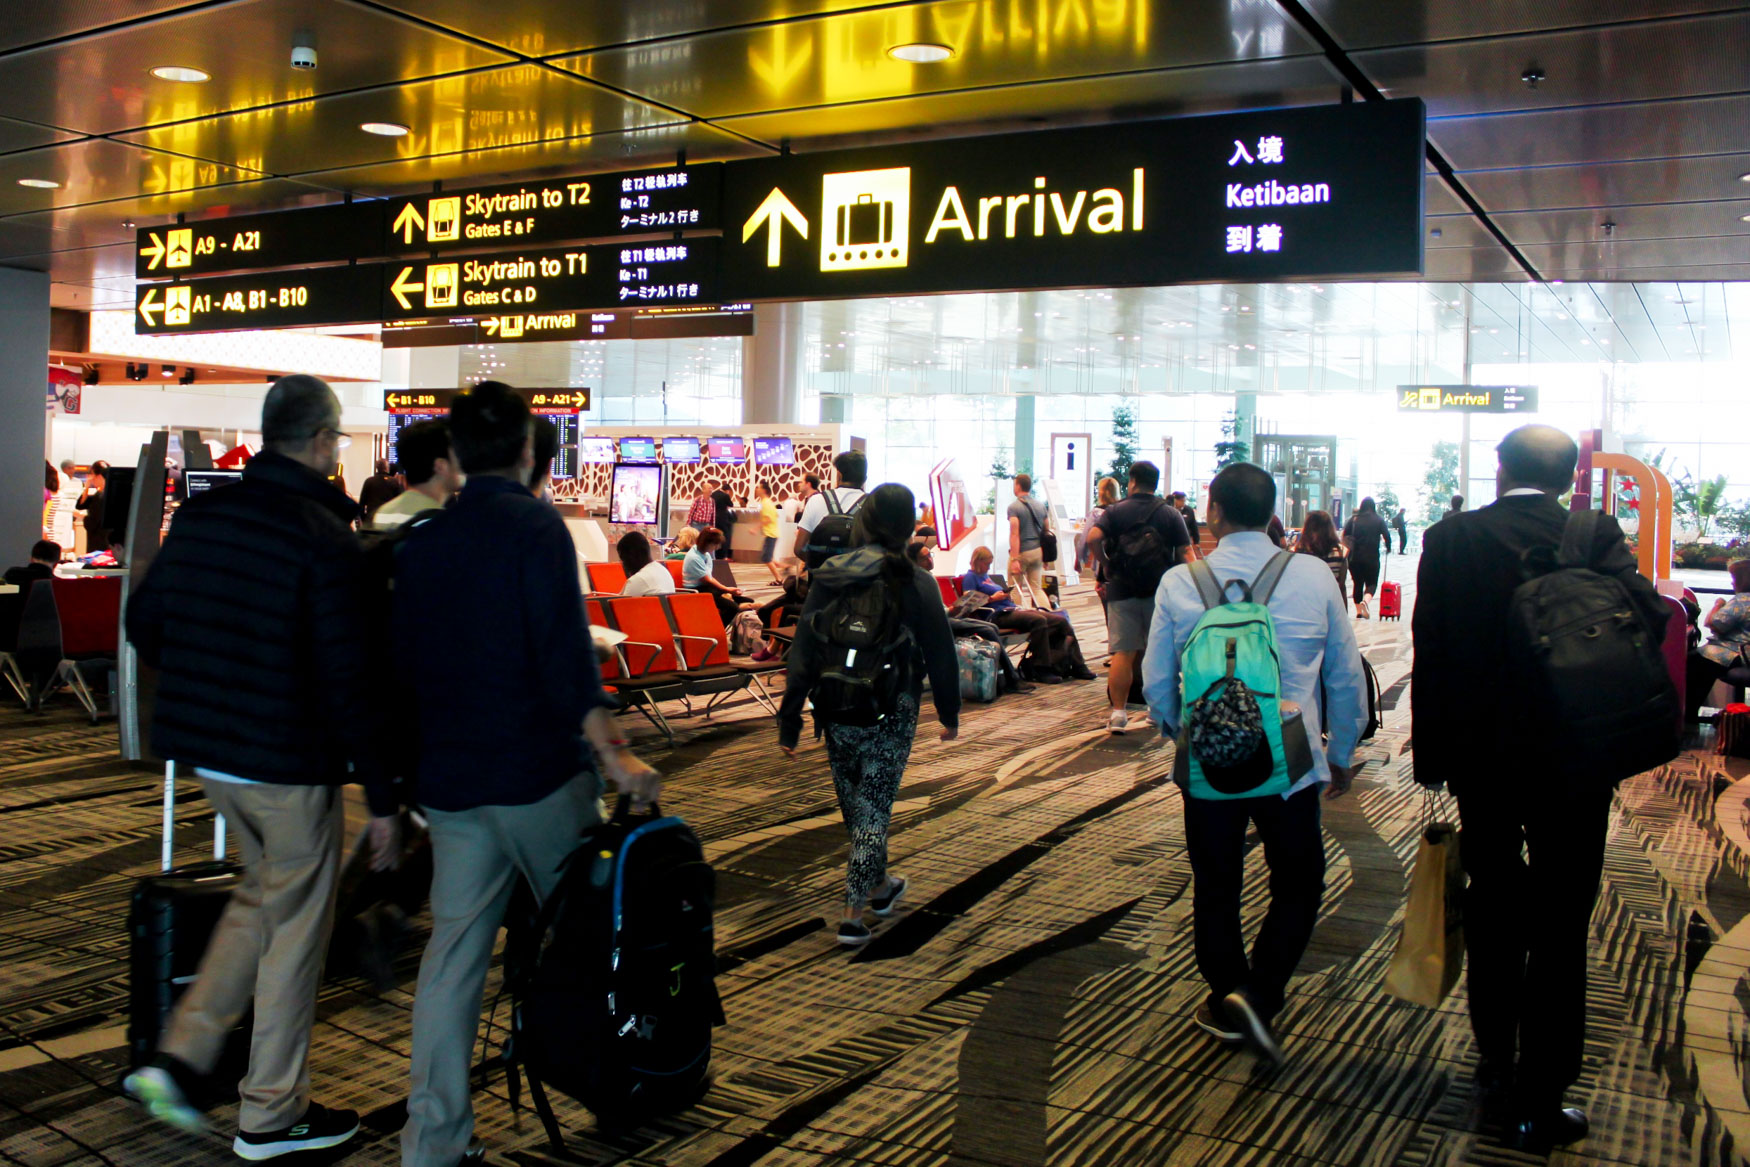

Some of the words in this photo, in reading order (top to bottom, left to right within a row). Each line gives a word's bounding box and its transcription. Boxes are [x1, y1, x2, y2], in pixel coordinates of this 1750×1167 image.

[1228, 136, 1283, 165] 入境
[466, 193, 537, 218] Skytrain
[542, 189, 563, 208] to
[567, 183, 590, 205] T2
[621, 198, 632, 209] Ke
[638, 196, 648, 207] T2
[1227, 180, 1329, 207] Ketibaan
[925, 168, 1143, 243] Arrival
[466, 224, 501, 238] Gates
[504, 220, 512, 235] E
[515, 222, 523, 234] &
[527, 218, 534, 233] F
[1226, 224, 1282, 252] 到着
[195, 236, 215, 255] A9
[233, 231, 260, 251] A21
[464, 257, 535, 286] Skytrain
[540, 257, 561, 277] to
[566, 253, 587, 275] T1
[620, 269, 631, 281] Ke
[637, 268, 647, 279] T1
[192, 295, 211, 313] A1
[249, 290, 267, 309] B1
[279, 287, 307, 307] B10
[464, 291, 499, 305] Gates
[501, 288, 511, 303] C
[514, 290, 522, 303] &
[525, 287, 536, 302] D
[525, 313, 576, 330] Arrival
[400, 396, 412, 406] B1
[418, 395, 436, 405] B10
[532, 395, 546, 405] A9
[552, 395, 571, 405] A21
[1443, 392, 1490, 406] Arrival
